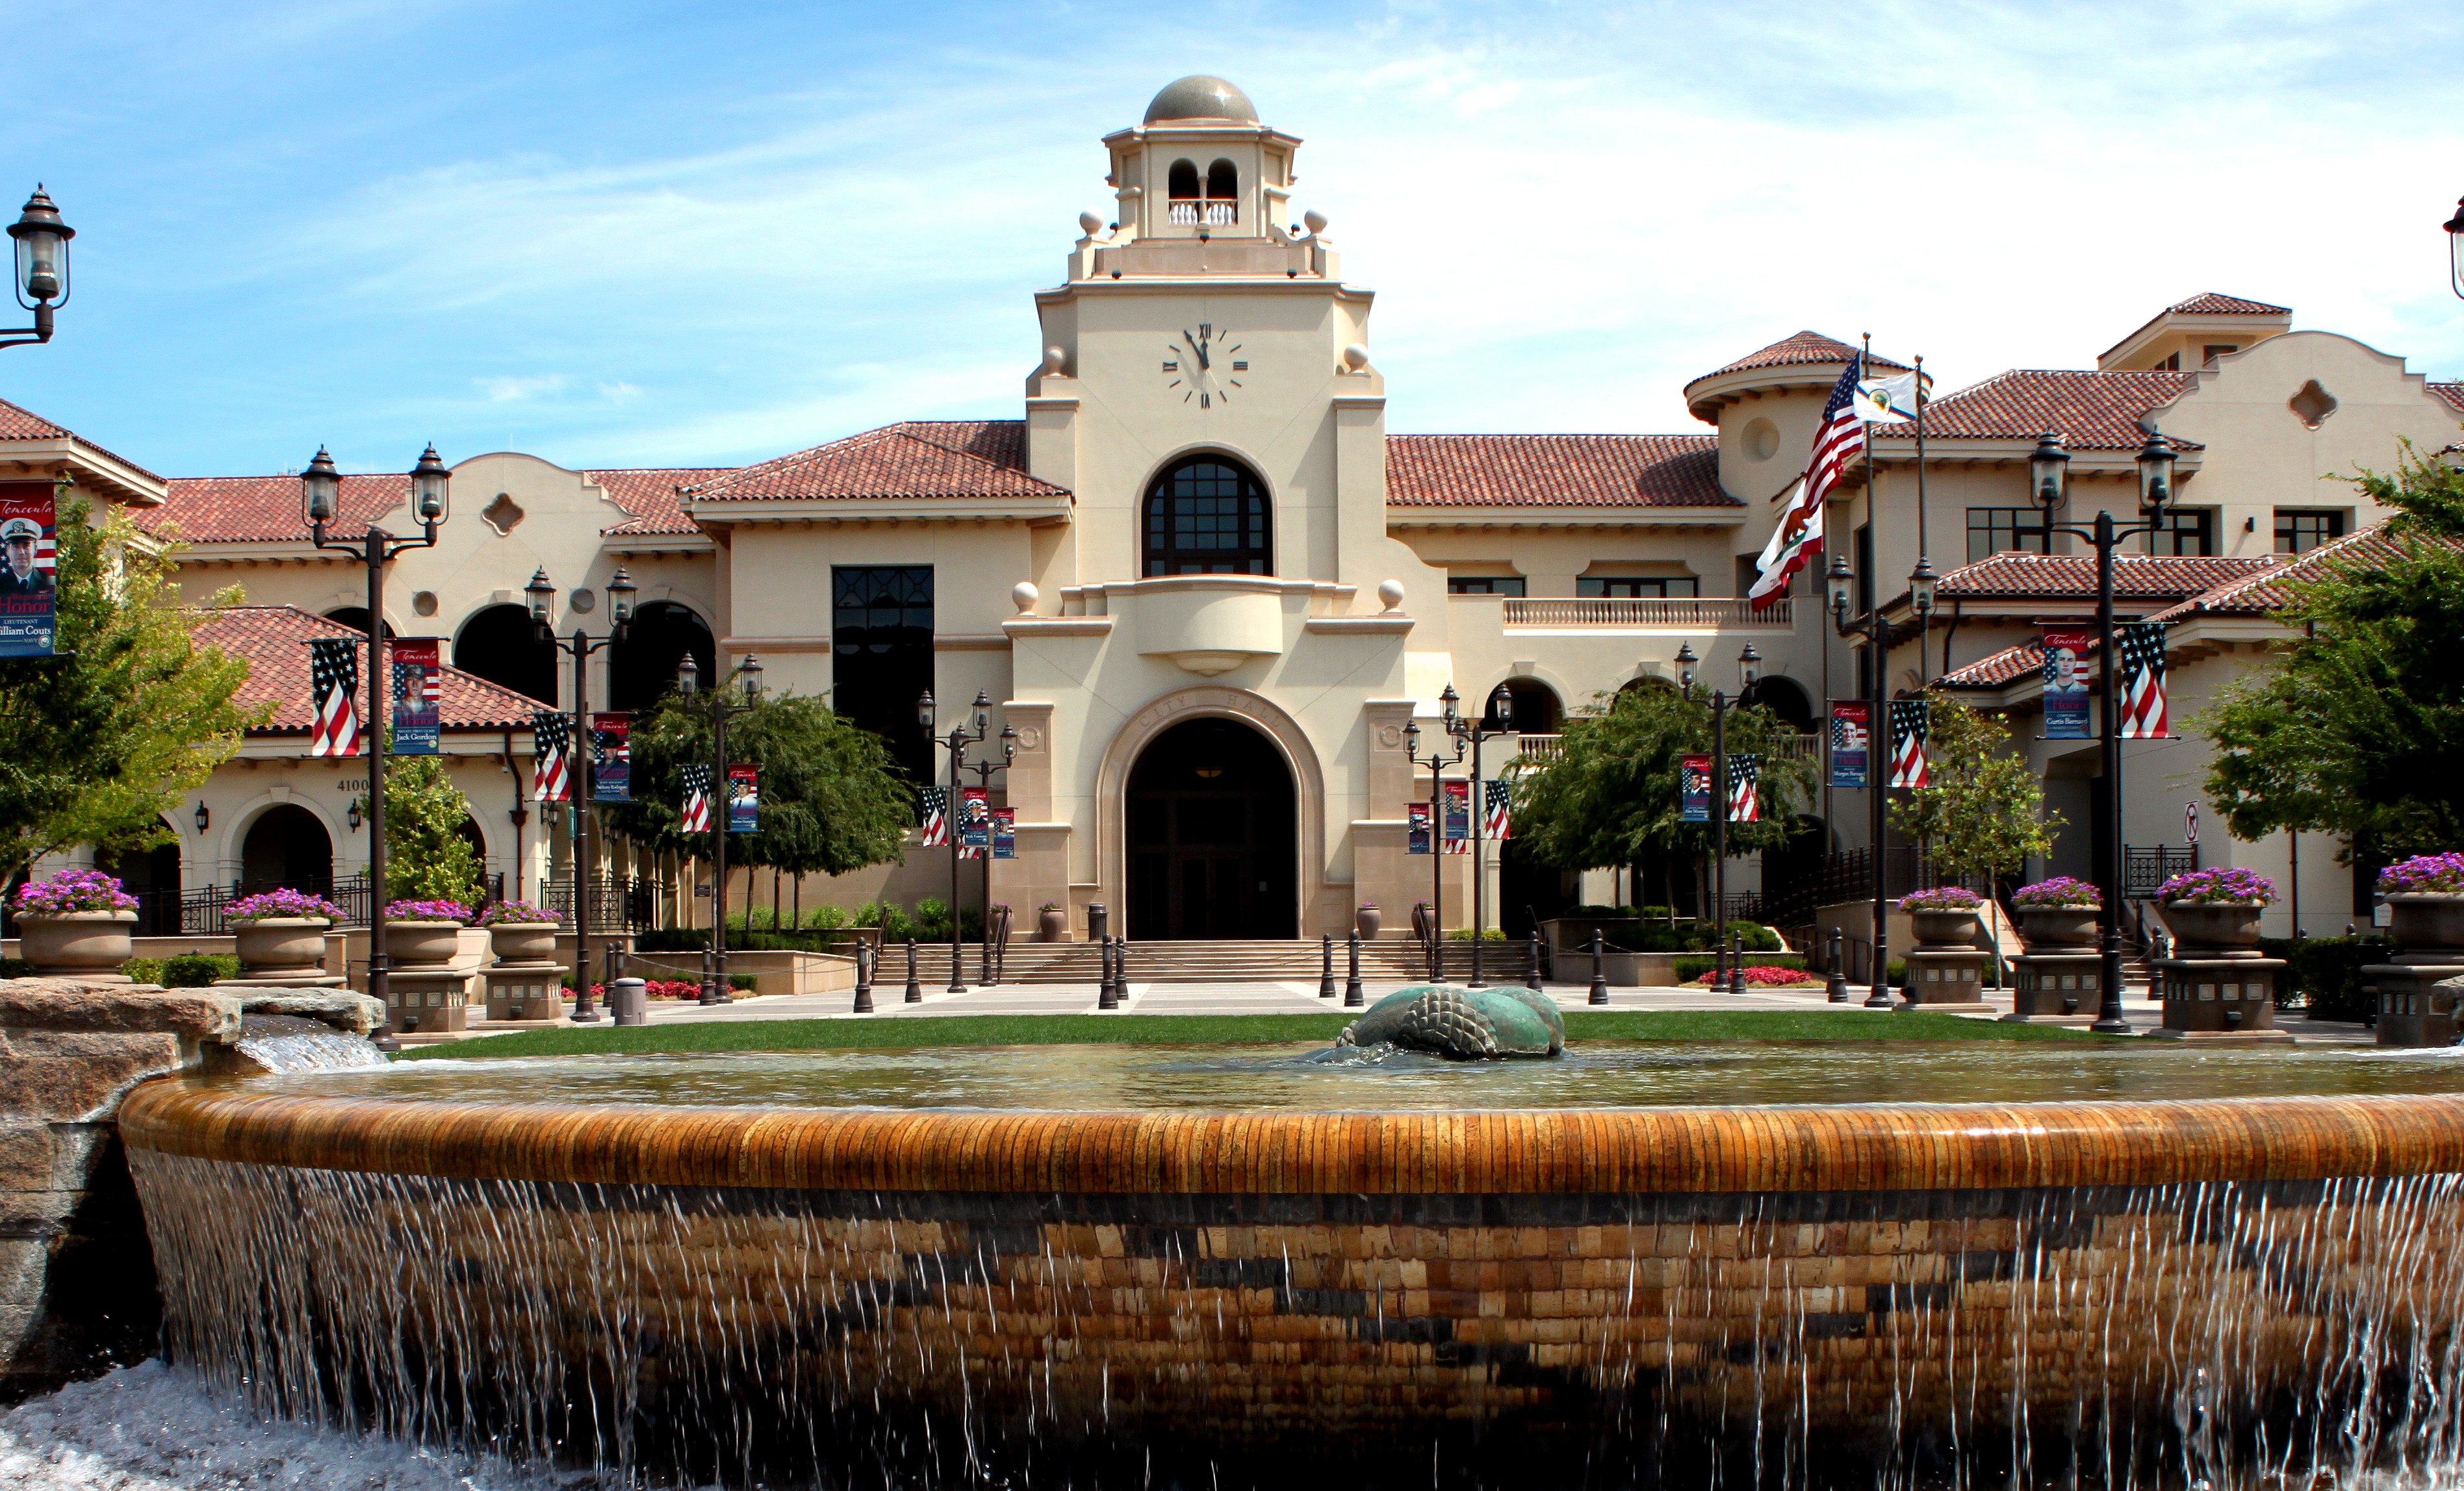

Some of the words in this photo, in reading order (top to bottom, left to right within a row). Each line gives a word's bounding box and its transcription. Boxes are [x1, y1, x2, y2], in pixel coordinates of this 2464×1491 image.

[0, 626, 25, 635] illiam
[25, 625, 52, 635] Couts
[394, 650, 437, 661] Temecula
[1140, 696, 1186, 726] CITY
[1227, 694, 1280, 728] HALL
[395, 733, 410, 742] Jack
